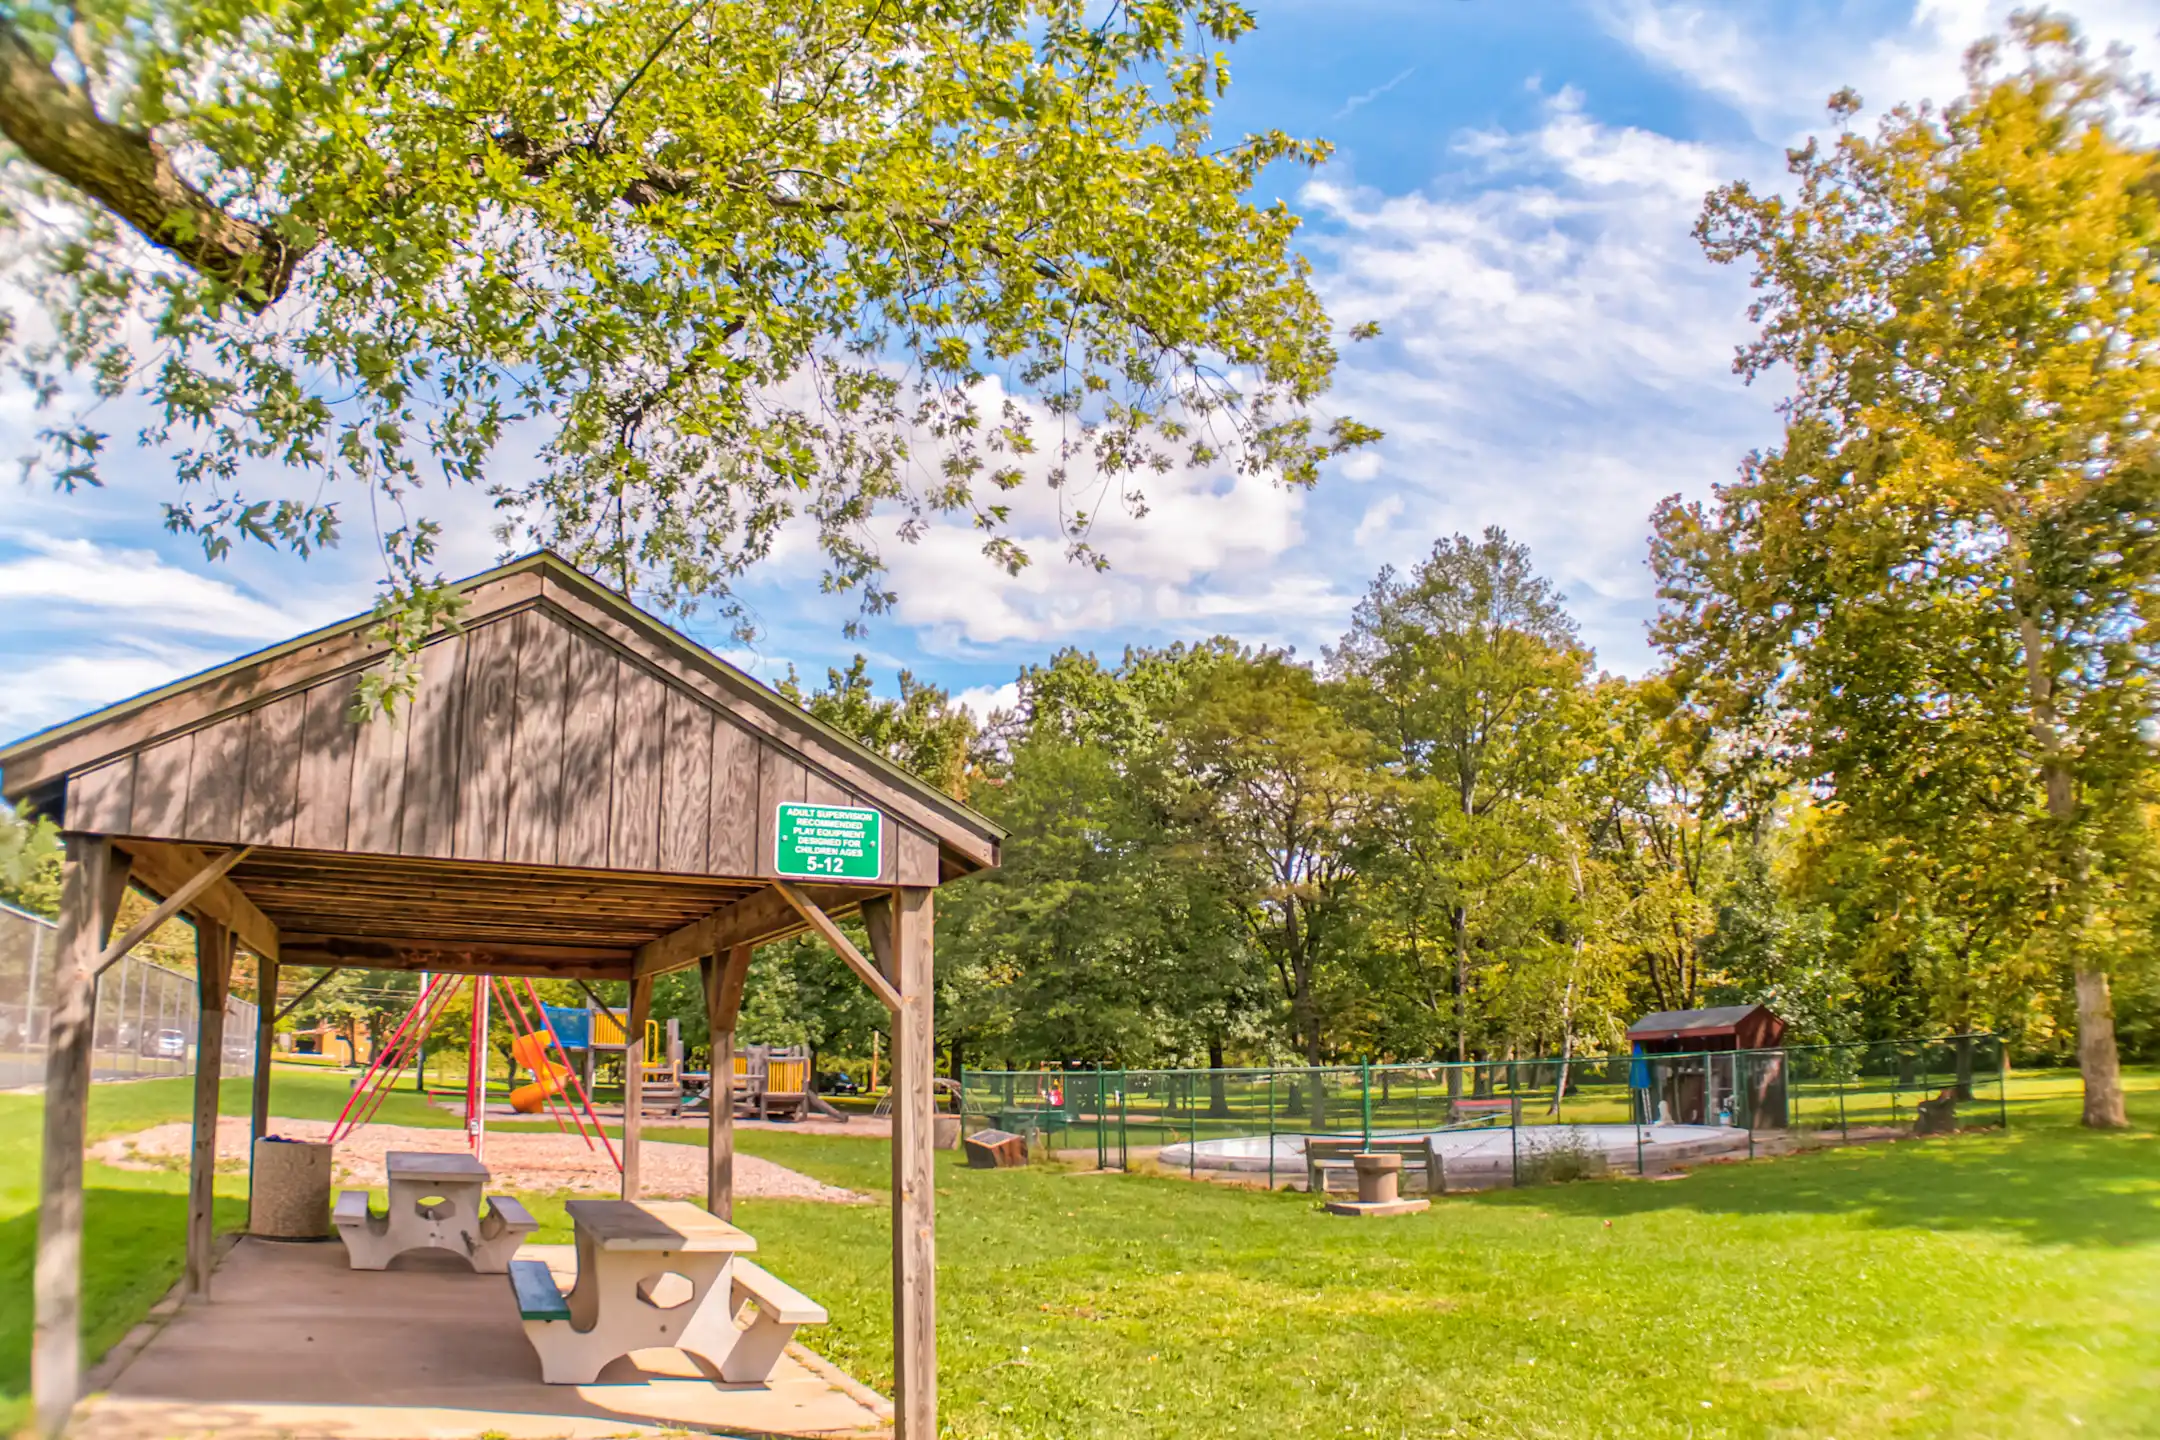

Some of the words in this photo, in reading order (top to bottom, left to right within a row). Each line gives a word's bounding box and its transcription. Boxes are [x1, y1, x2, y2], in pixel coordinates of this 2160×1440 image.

[786, 808, 815, 817] ADULT
[816, 810, 873, 821] SUPERVISION
[793, 827, 815, 835] PLAY
[816, 828, 866, 838] EQUIPMENT
[843, 839, 861, 847] FOR
[795, 845, 838, 855] CHILDREN
[839, 849, 863, 857] AGES
[807, 856, 844, 872] 5-12
